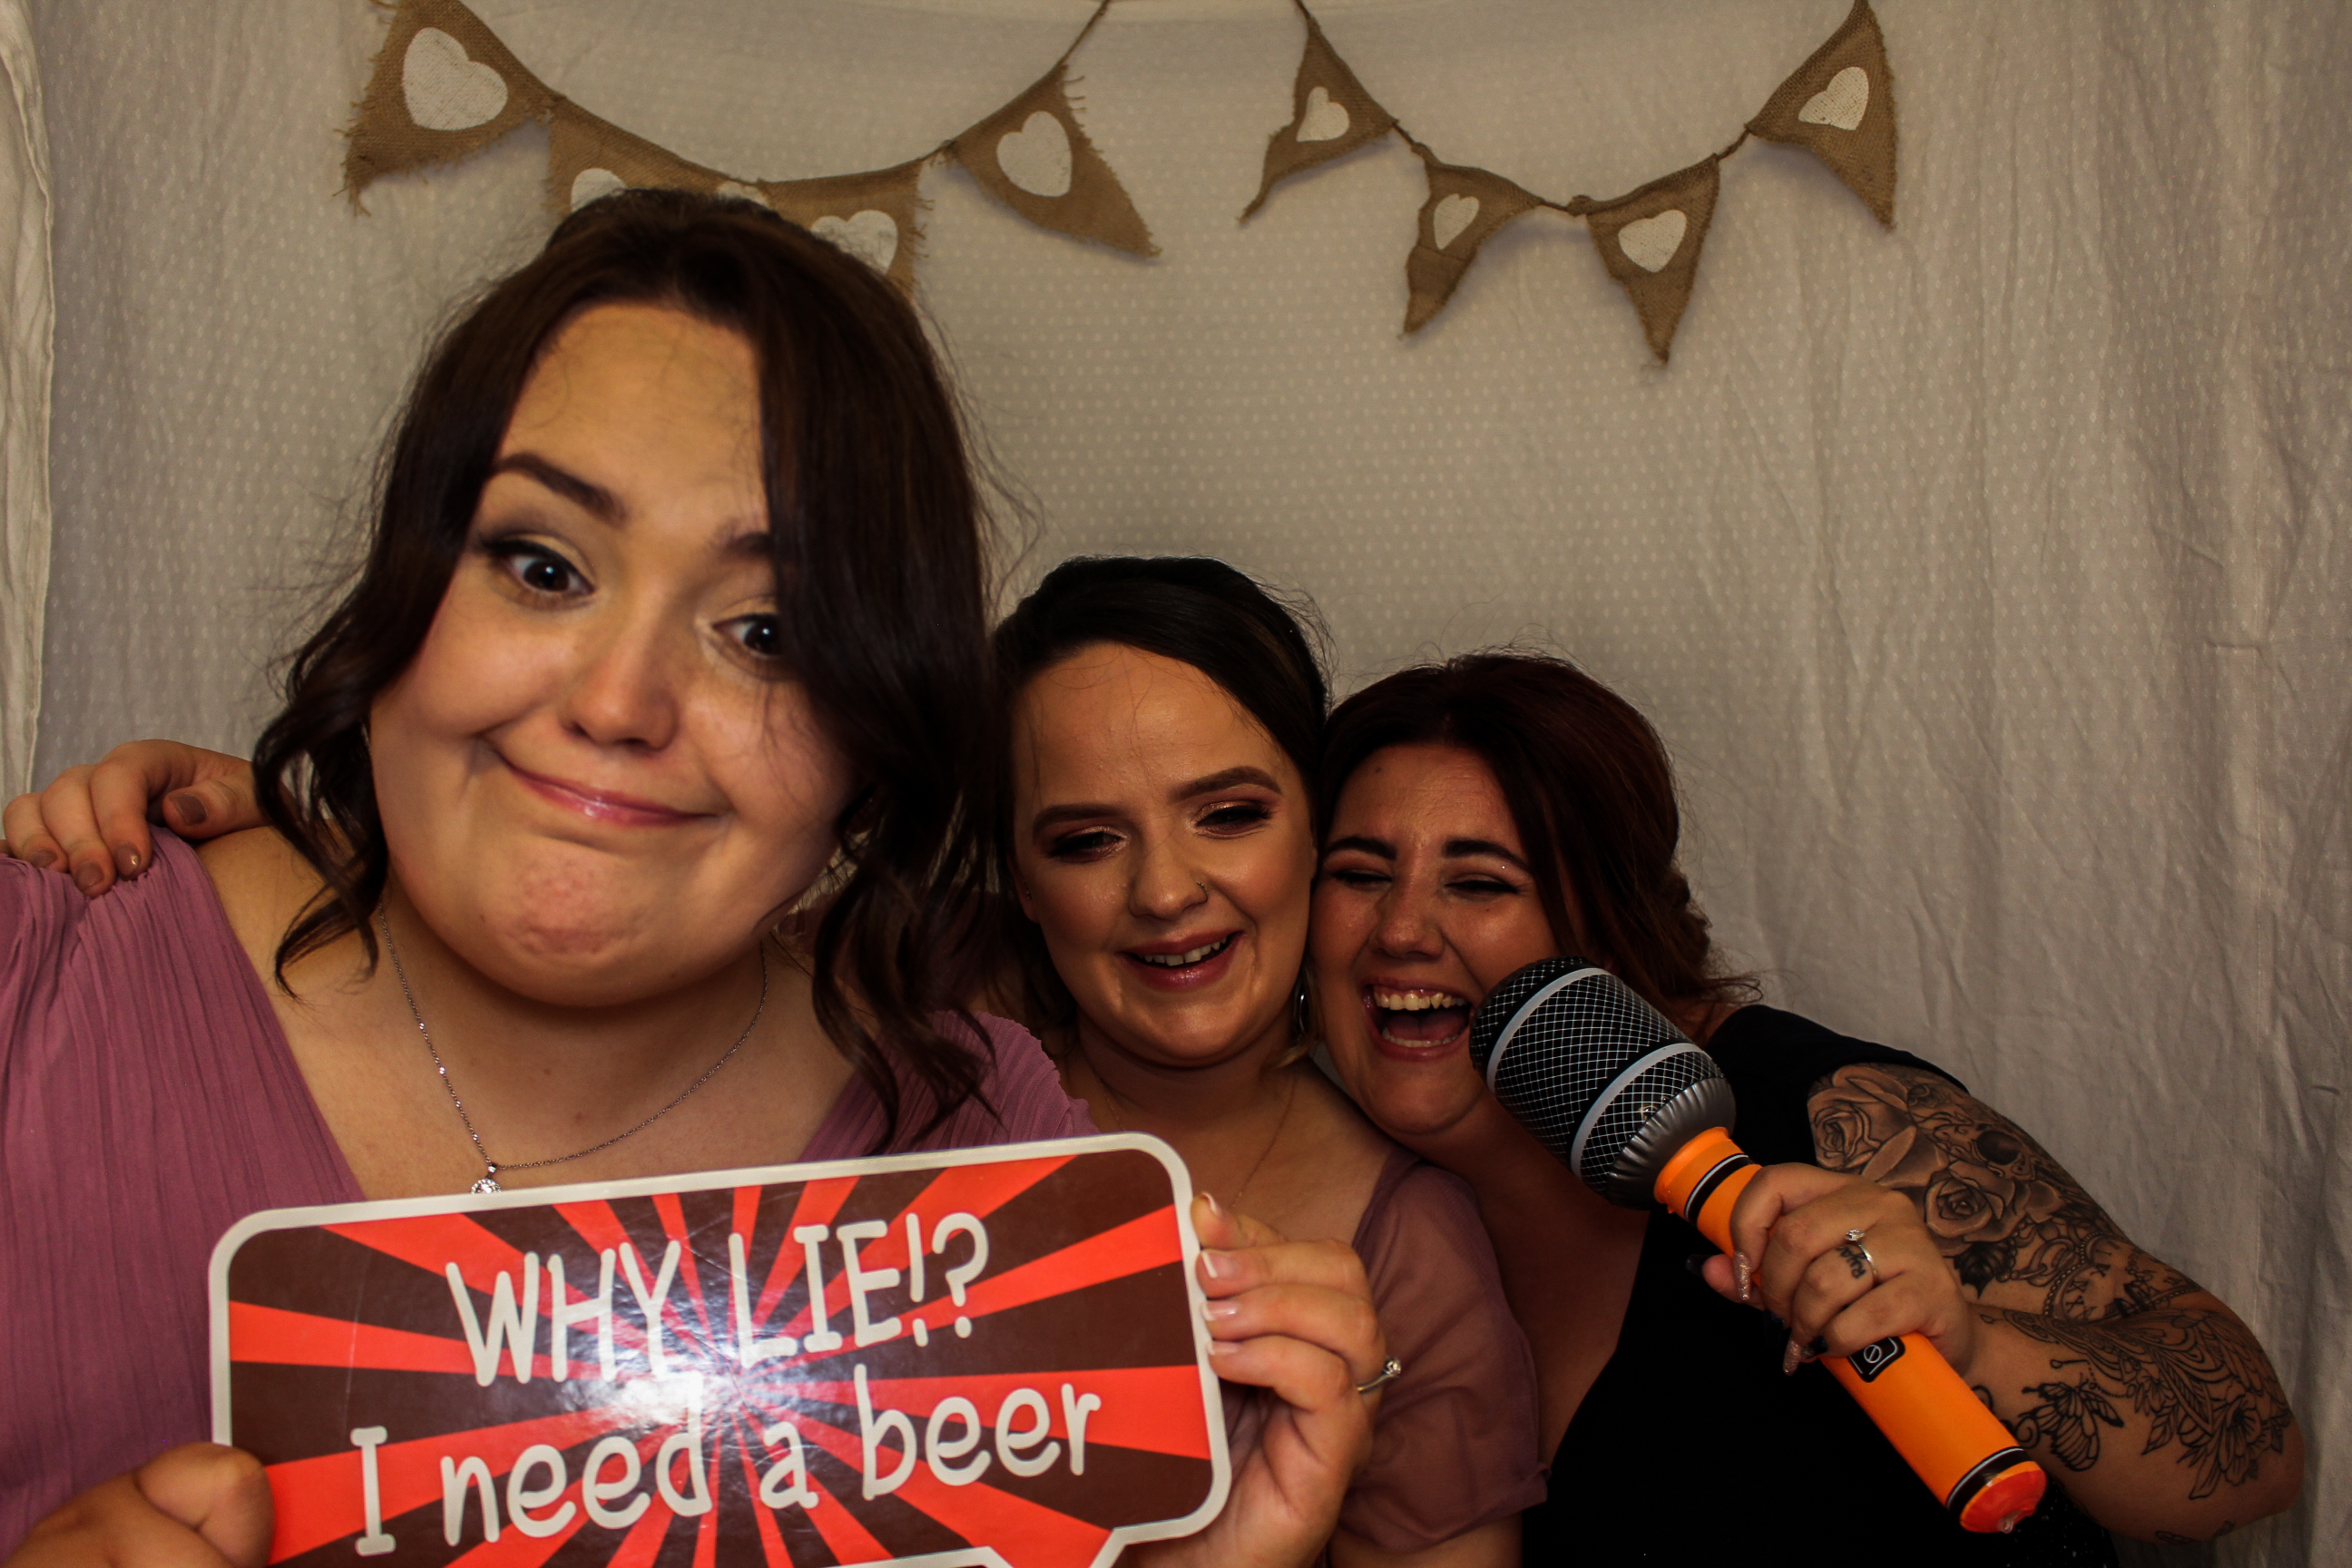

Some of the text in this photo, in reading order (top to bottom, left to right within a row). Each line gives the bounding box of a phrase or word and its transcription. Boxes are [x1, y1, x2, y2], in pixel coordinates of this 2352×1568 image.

[445, 1212, 989, 1387] WHY LIE!?
[350, 1363, 1102, 1556] I need a beer
